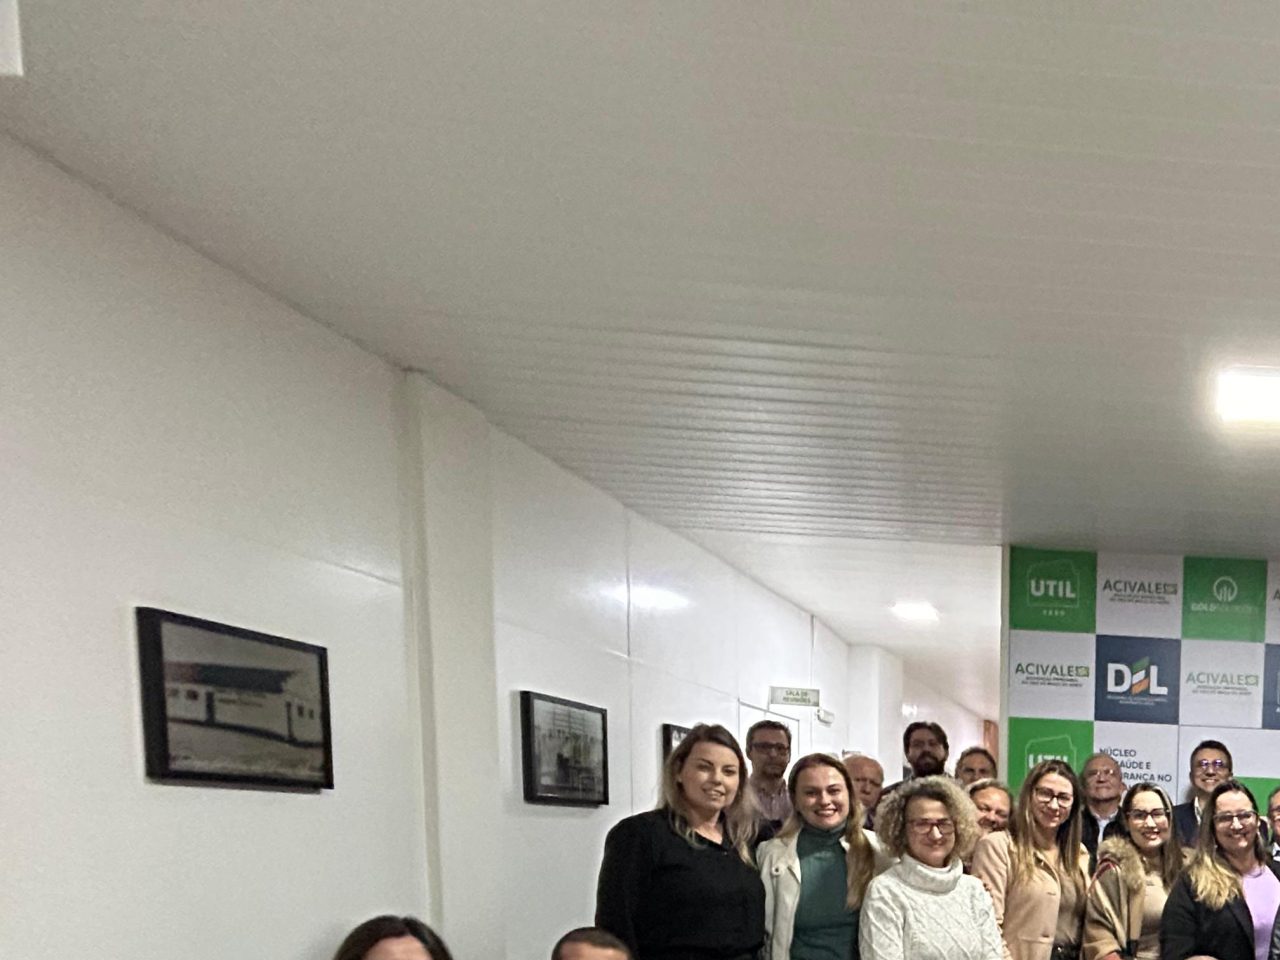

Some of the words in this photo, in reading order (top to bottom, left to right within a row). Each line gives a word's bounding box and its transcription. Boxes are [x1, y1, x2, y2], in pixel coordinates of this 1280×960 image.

[1030, 579, 1077, 598] UTIL
[1102, 579, 1165, 594] ACIVALE
[1015, 663, 1074, 677] ACIVALE
[1185, 672, 1246, 686] ACIVALE
[1119, 759, 1144, 770] AÚDE
[1146, 762, 1151, 770] E
[1122, 772, 1156, 781] RANÇA
[1157, 773, 1172, 783] NO
